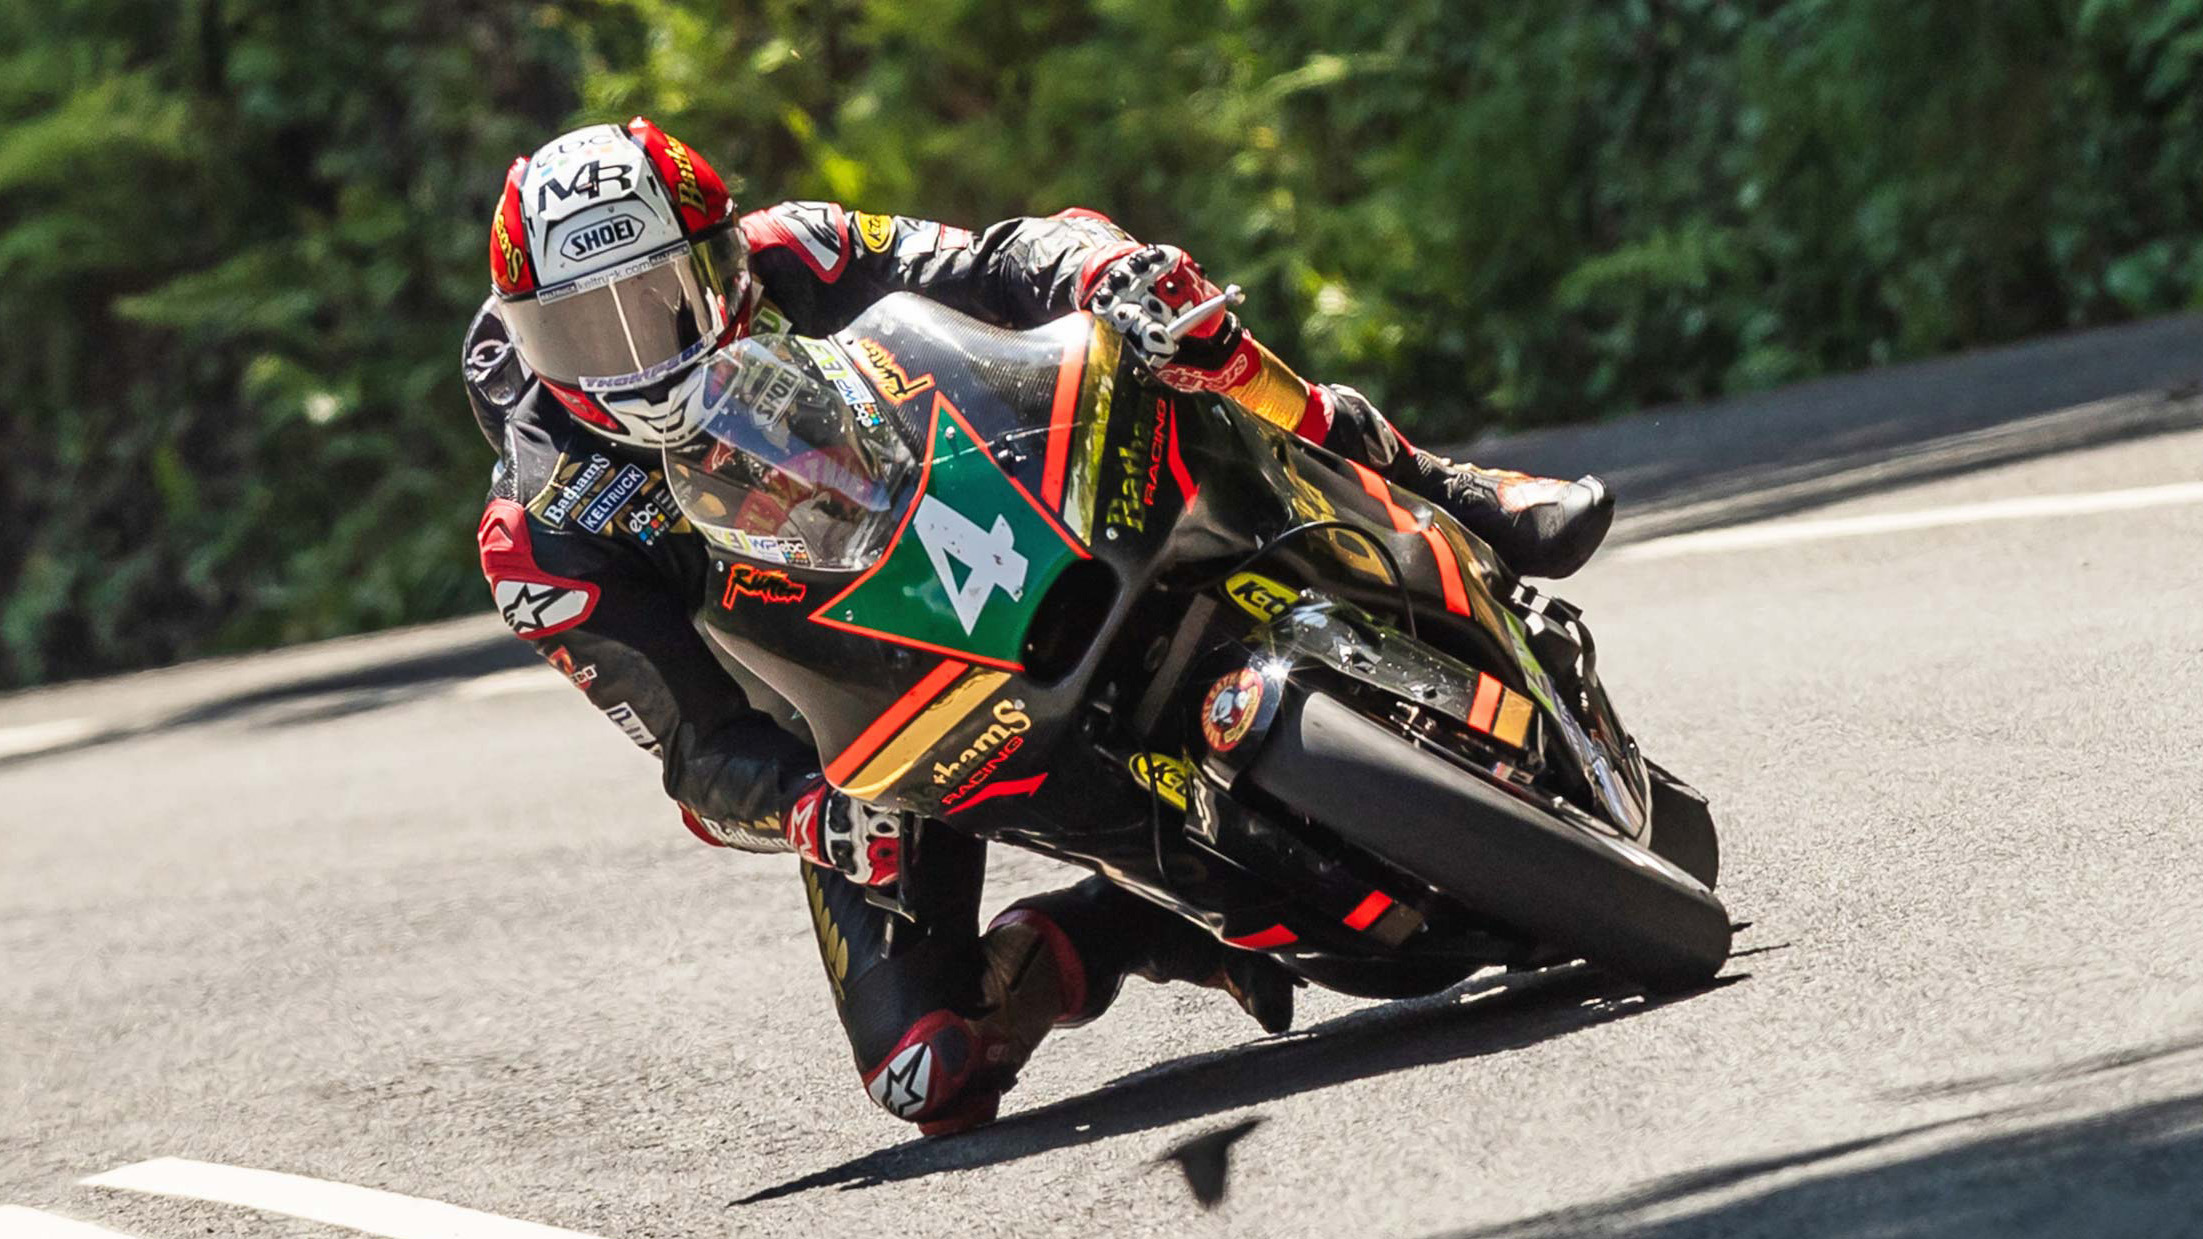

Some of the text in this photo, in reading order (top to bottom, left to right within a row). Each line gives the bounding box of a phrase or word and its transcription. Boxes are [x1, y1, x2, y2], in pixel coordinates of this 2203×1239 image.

[570, 219, 635, 256] SHOEI
[756, 368, 799, 421] SHOEI
[1143, 398, 1167, 506] RACING
[585, 469, 641, 529] KELTRUCK
[629, 502, 659, 533] ebc
[912, 493, 1029, 637] 4
[941, 735, 1024, 804] RACING
